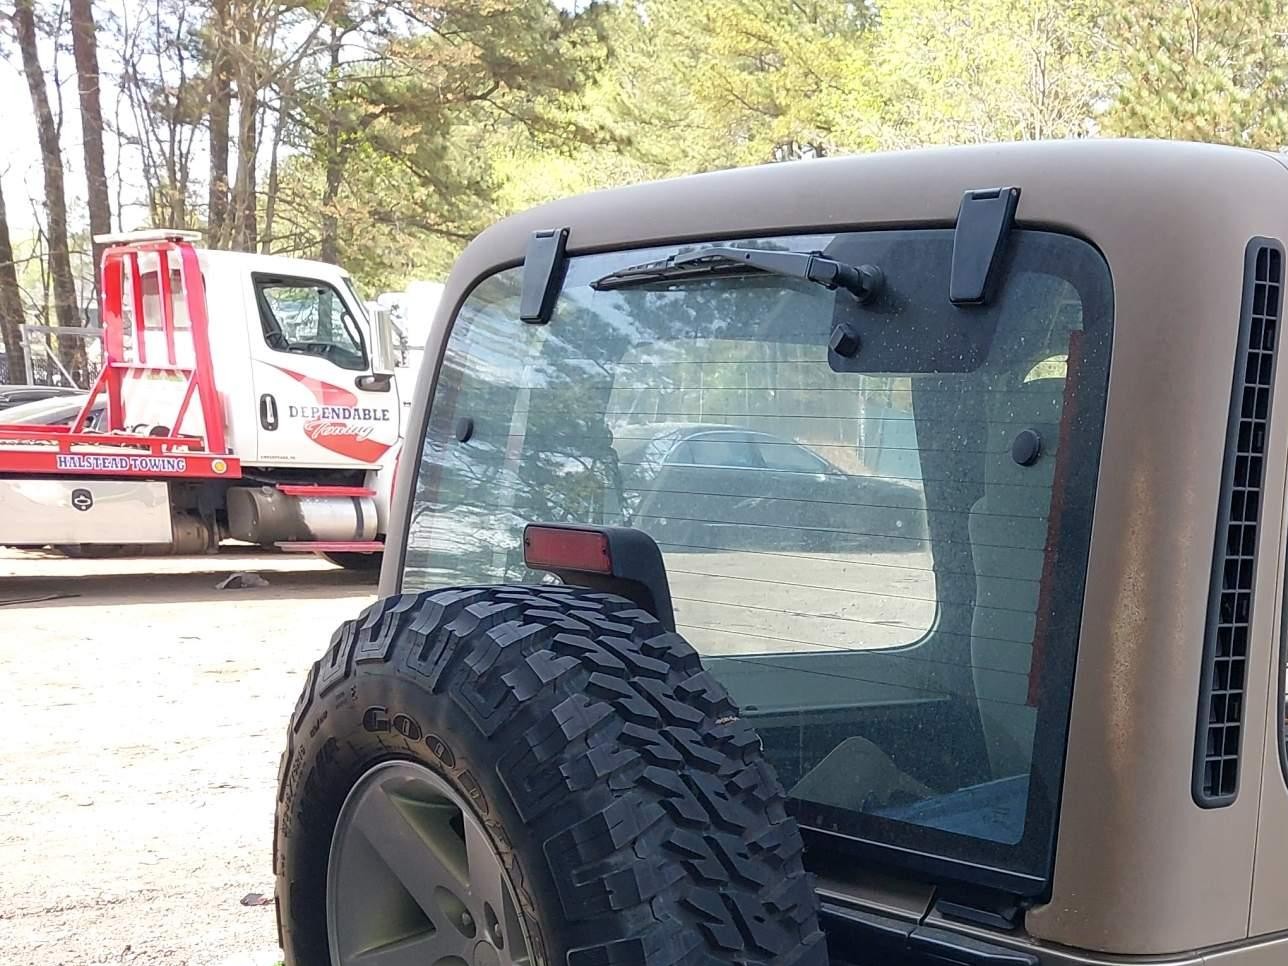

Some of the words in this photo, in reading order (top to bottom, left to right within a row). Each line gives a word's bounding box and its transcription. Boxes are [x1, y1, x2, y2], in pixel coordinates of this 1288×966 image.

[288, 405, 390, 421] DEPENDABLE
[303, 419, 374, 441] Towing
[57, 455, 128, 470] HALSTEAD
[131, 457, 187, 471] TOWING
